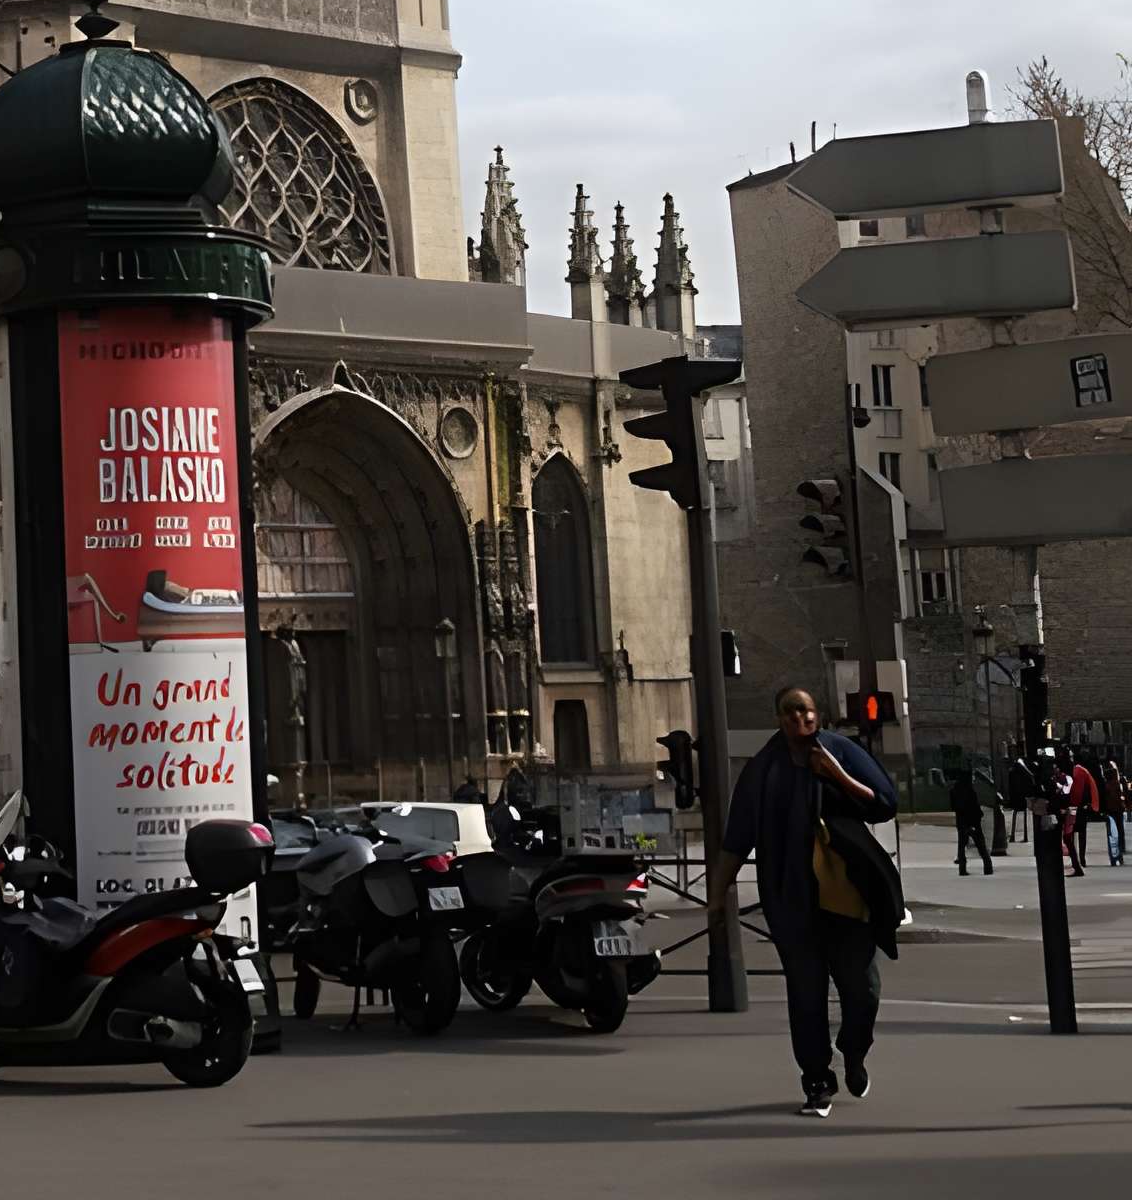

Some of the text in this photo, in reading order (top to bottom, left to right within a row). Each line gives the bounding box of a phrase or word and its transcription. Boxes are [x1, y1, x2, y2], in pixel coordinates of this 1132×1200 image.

[100, 407, 220, 452] JOSIANE
[99, 456, 225, 503] BALASKO
[97, 661, 232, 710] Un grand
[116, 746, 235, 791] solitude
